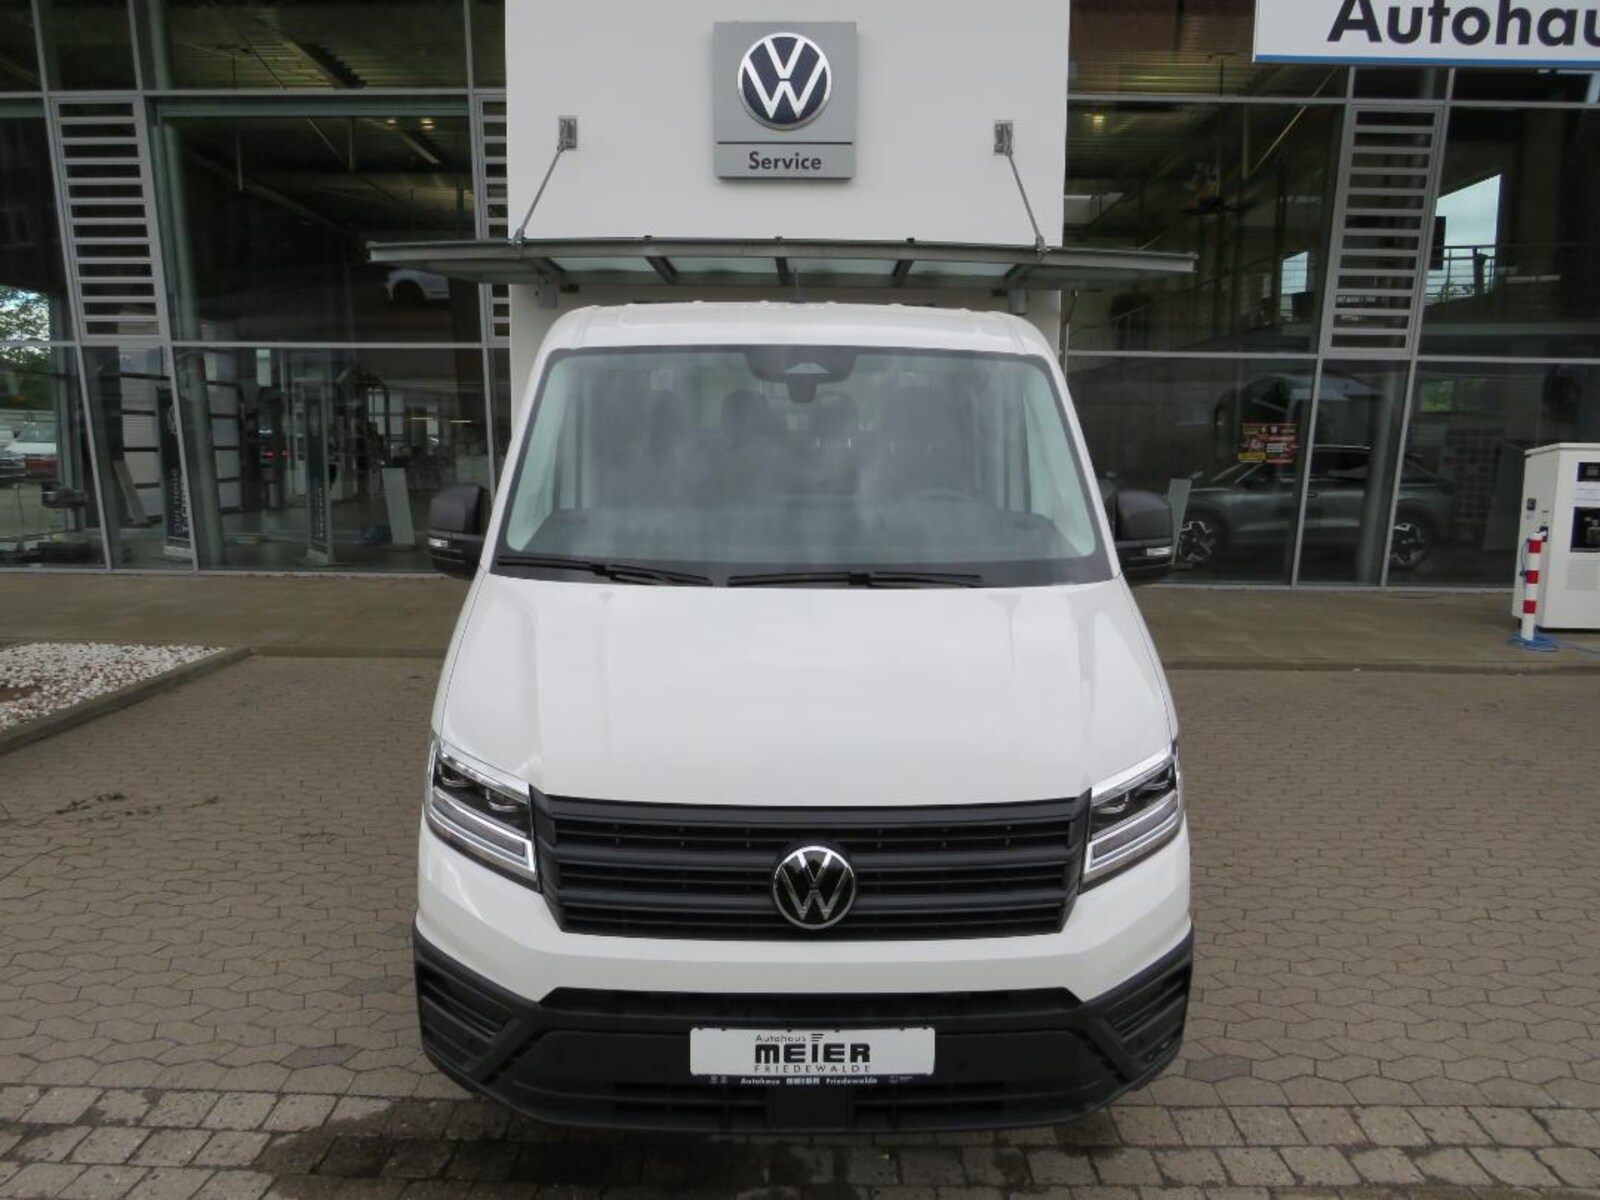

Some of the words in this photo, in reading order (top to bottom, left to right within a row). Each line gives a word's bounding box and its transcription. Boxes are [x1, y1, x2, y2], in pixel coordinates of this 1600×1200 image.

[738, 32, 832, 129] VW
[748, 150, 822, 170] Service
[773, 845, 856, 930] VW
[755, 1034, 807, 1043] Autohaus
[755, 1044, 870, 1063] MEIER
[754, 1064, 872, 1073] FRIEDEWALDE
